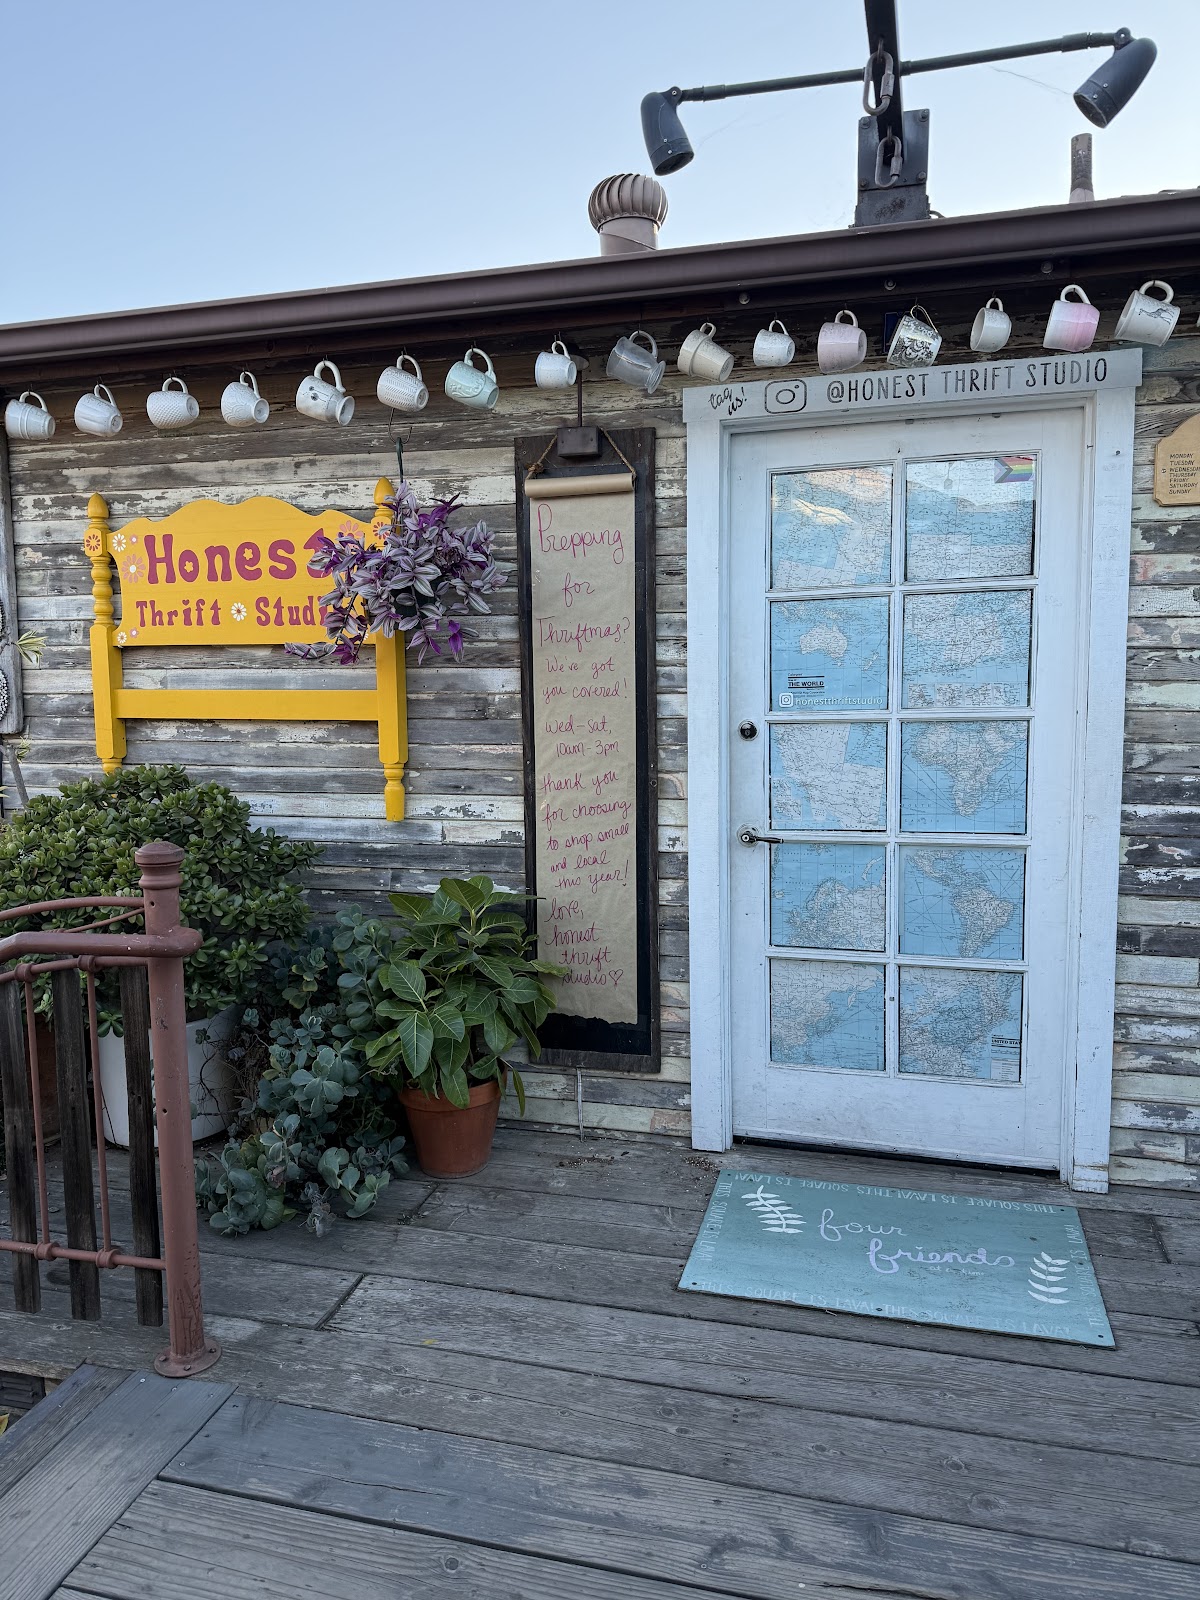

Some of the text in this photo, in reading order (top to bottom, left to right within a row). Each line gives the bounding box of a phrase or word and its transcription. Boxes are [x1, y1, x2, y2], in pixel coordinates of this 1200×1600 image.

[826, 357, 1108, 404] @HONEST THRIFT STUDIO
[708, 388, 732, 410] tag
[728, 386, 747, 416] us!
[538, 504, 624, 564] Prepping
[562, 572, 596, 608] for
[135, 595, 329, 628] Thrift Studi
[536, 616, 630, 652] Thriftmas?
[545, 655, 615, 680] We've got
[542, 677, 627, 704] you covered!
[794, 696, 883, 706] honestthriftstudio
[540, 770, 619, 796] thank you
[542, 800, 632, 831] for choosing
[546, 822, 630, 851] to shop small
[550, 850, 610, 872] and local
[555, 860, 628, 894] this year!
[544, 897, 584, 922] love,
[545, 921, 604, 946] honest
[559, 946, 612, 972] thrift
[562, 968, 607, 986] studio
[715, 1182, 733, 1198] THIS
[734, 1172, 1057, 1214] THIS SQUARE IS LAVA! THIS SQUARE IS LAVA!
[706, 1200, 728, 1229] SQUARE
[817, 1208, 908, 1242] four
[702, 1230, 720, 1239] IS
[866, 1238, 1016, 1274] friends
[1070, 1249, 1088, 1260] IS
[702, 1281, 734, 1293] THIS
[744, 1286, 802, 1302] SQUARE
[809, 1294, 827, 1307] IS
[836, 1298, 876, 1314] LAVA!
[883, 1304, 918, 1318] THIS
